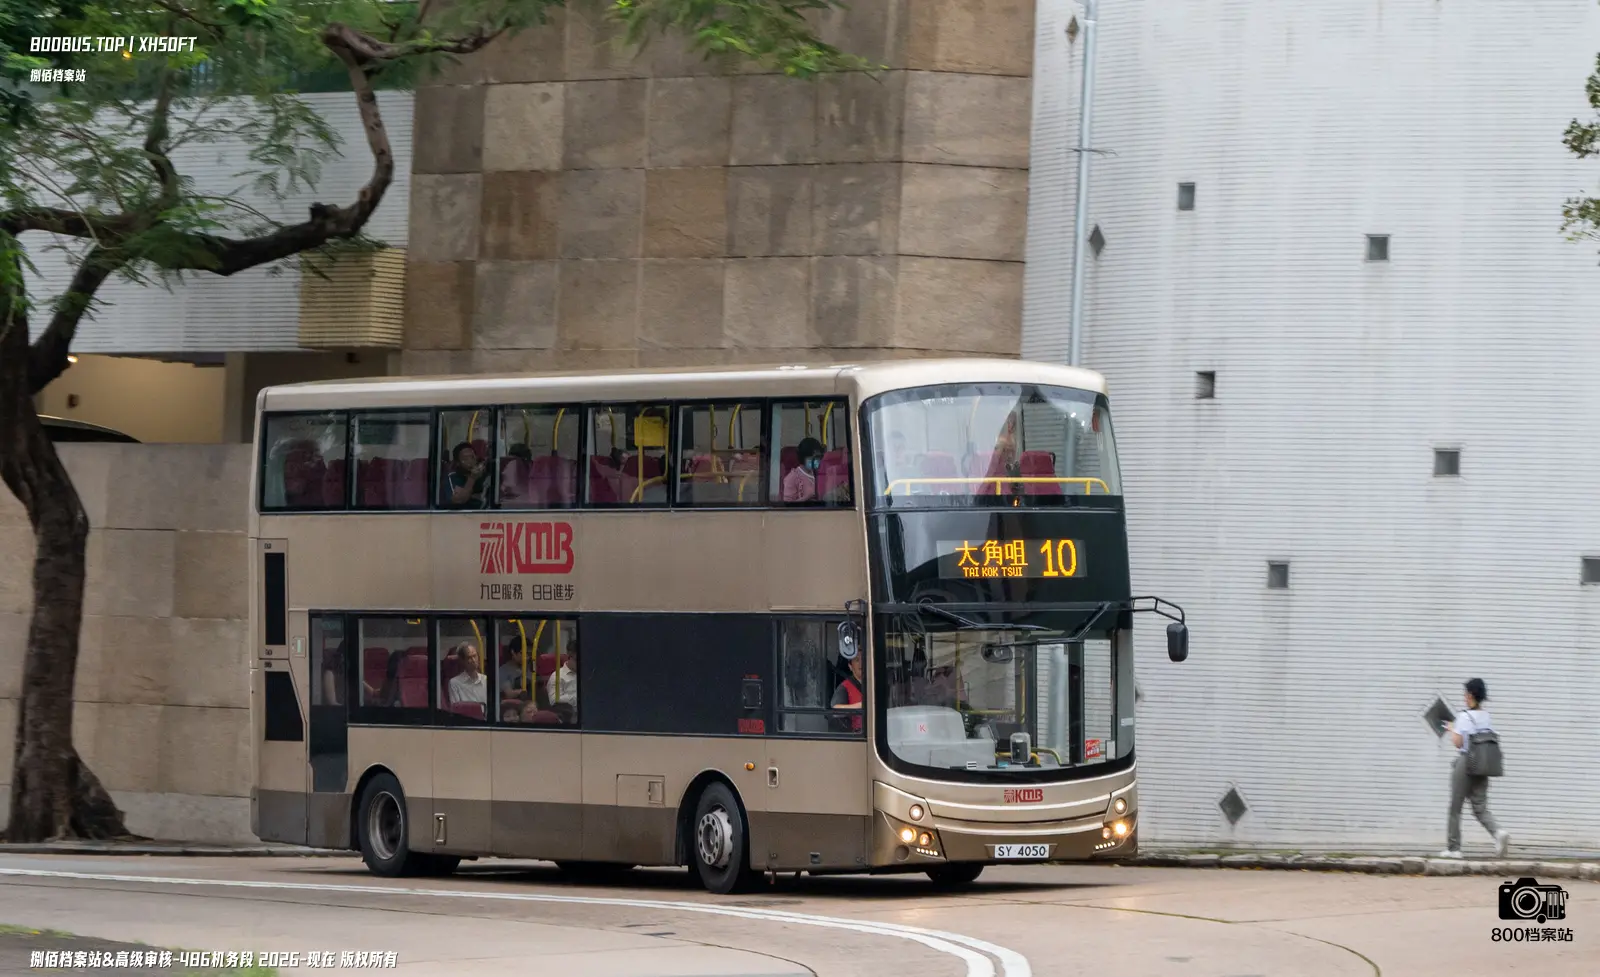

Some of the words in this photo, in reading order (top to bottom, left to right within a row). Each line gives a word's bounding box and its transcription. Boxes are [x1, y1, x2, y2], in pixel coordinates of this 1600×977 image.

[505, 522, 575, 574] KMB
[955, 539, 1029, 567] 大角咀
[1039, 538, 1078, 577] 10
[962, 566, 980, 577] TAI
[981, 566, 999, 577] KOK
[1001, 566, 1023, 577] TSUI
[480, 583, 524, 600] 九巴服務
[532, 584, 575, 600] 日日進步
[1015, 788, 1044, 803] KMB
[997, 845, 1013, 857] SY
[1017, 845, 1047, 857] 4050
